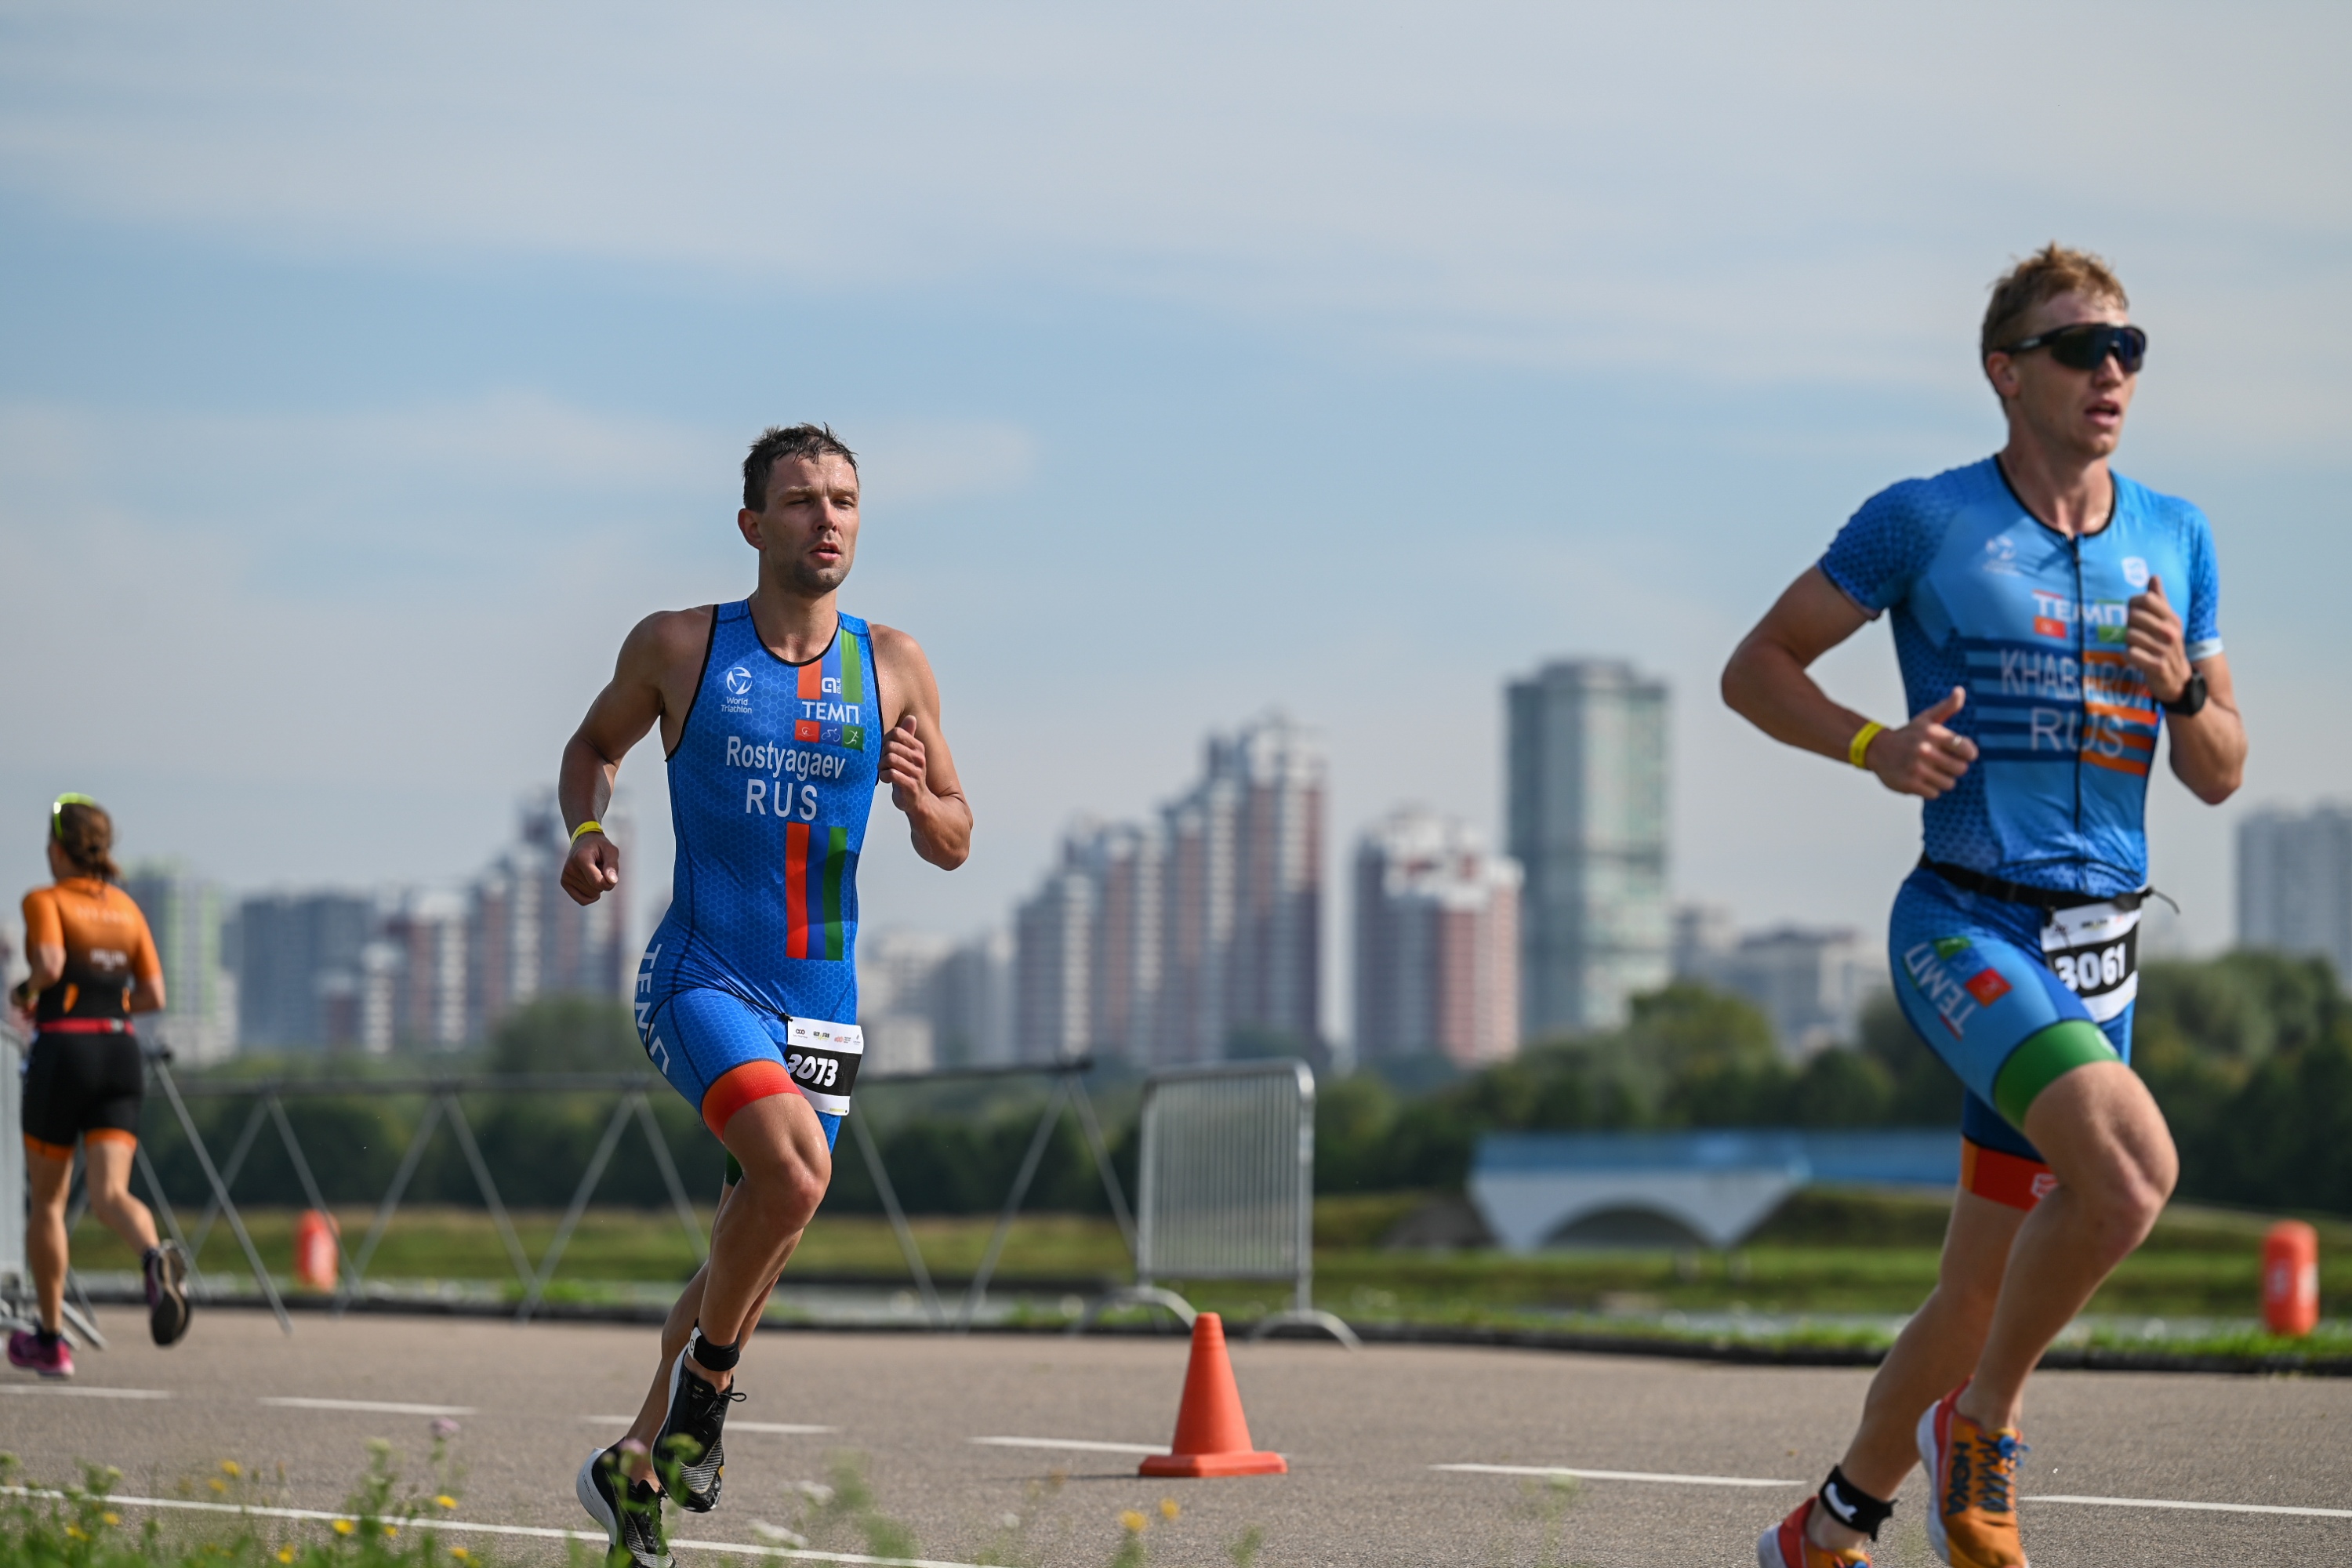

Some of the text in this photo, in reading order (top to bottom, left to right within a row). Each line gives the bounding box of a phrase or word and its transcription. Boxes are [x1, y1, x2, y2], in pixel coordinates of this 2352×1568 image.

[720, 704, 753, 714] Triathlon
[726, 696, 749, 706] World
[2031, 706, 2125, 757] RUS
[726, 736, 846, 781] Rostyagaev
[746, 779, 818, 821] RUS
[2054, 942, 2126, 992] 3061
[788, 1054, 839, 1087] 3073
[1947, 1442, 1971, 1515] HOKA
